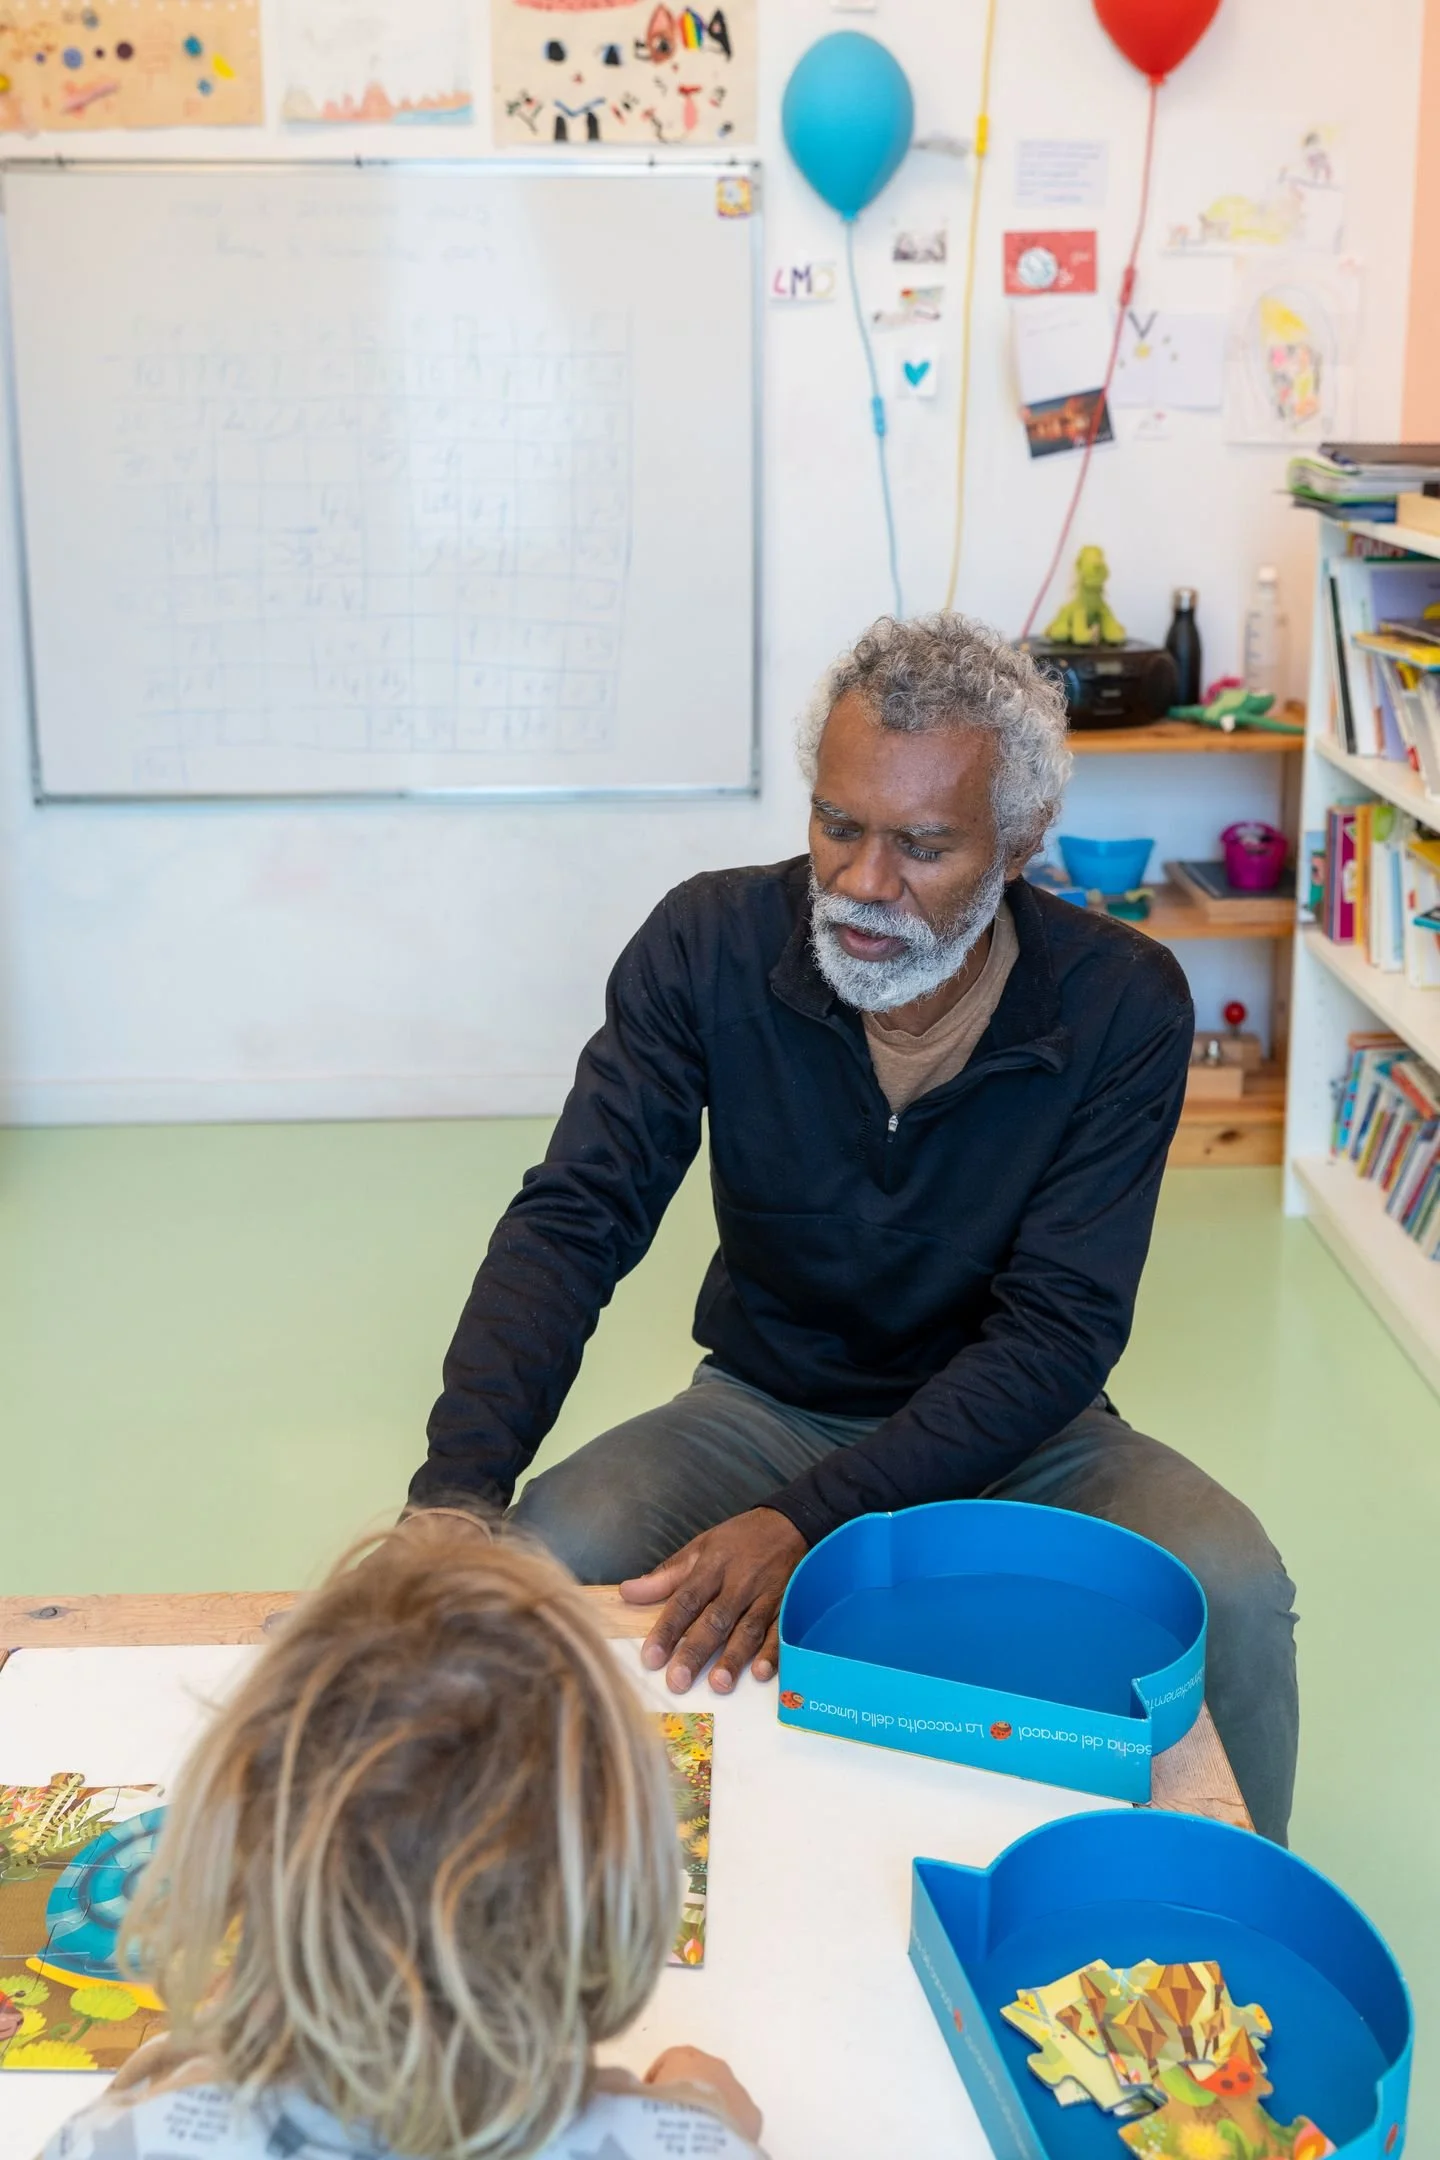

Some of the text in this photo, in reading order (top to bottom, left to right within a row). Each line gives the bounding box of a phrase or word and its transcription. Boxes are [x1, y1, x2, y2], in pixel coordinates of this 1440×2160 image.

[809, 1699, 985, 1738] La raccolta della lumaca
[1018, 1725, 1078, 1744] caracol
[1081, 1734, 1104, 1751] del
